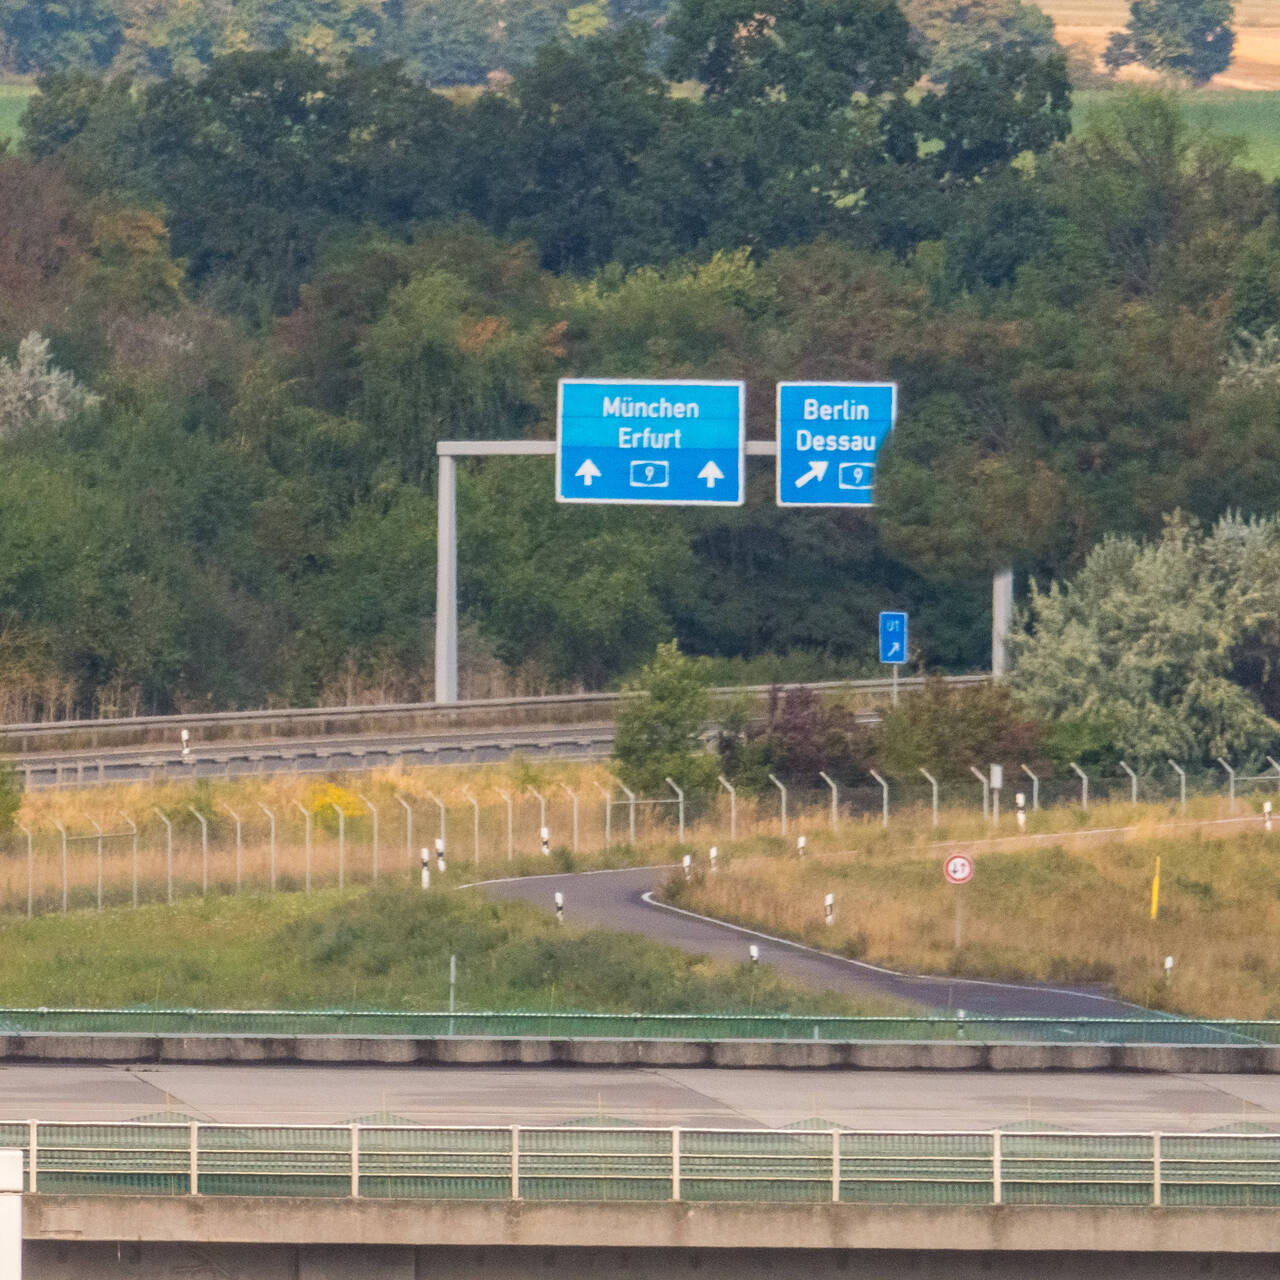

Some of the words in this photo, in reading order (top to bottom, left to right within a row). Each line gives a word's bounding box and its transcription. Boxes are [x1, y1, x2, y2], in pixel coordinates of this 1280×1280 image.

[602, 396, 700, 419] München
[803, 398, 869, 421] Berlin
[618, 426, 681, 449] Erfurt
[796, 429, 876, 451] Dessau
[644, 465, 655, 481] 9
[853, 467, 864, 484] 9
